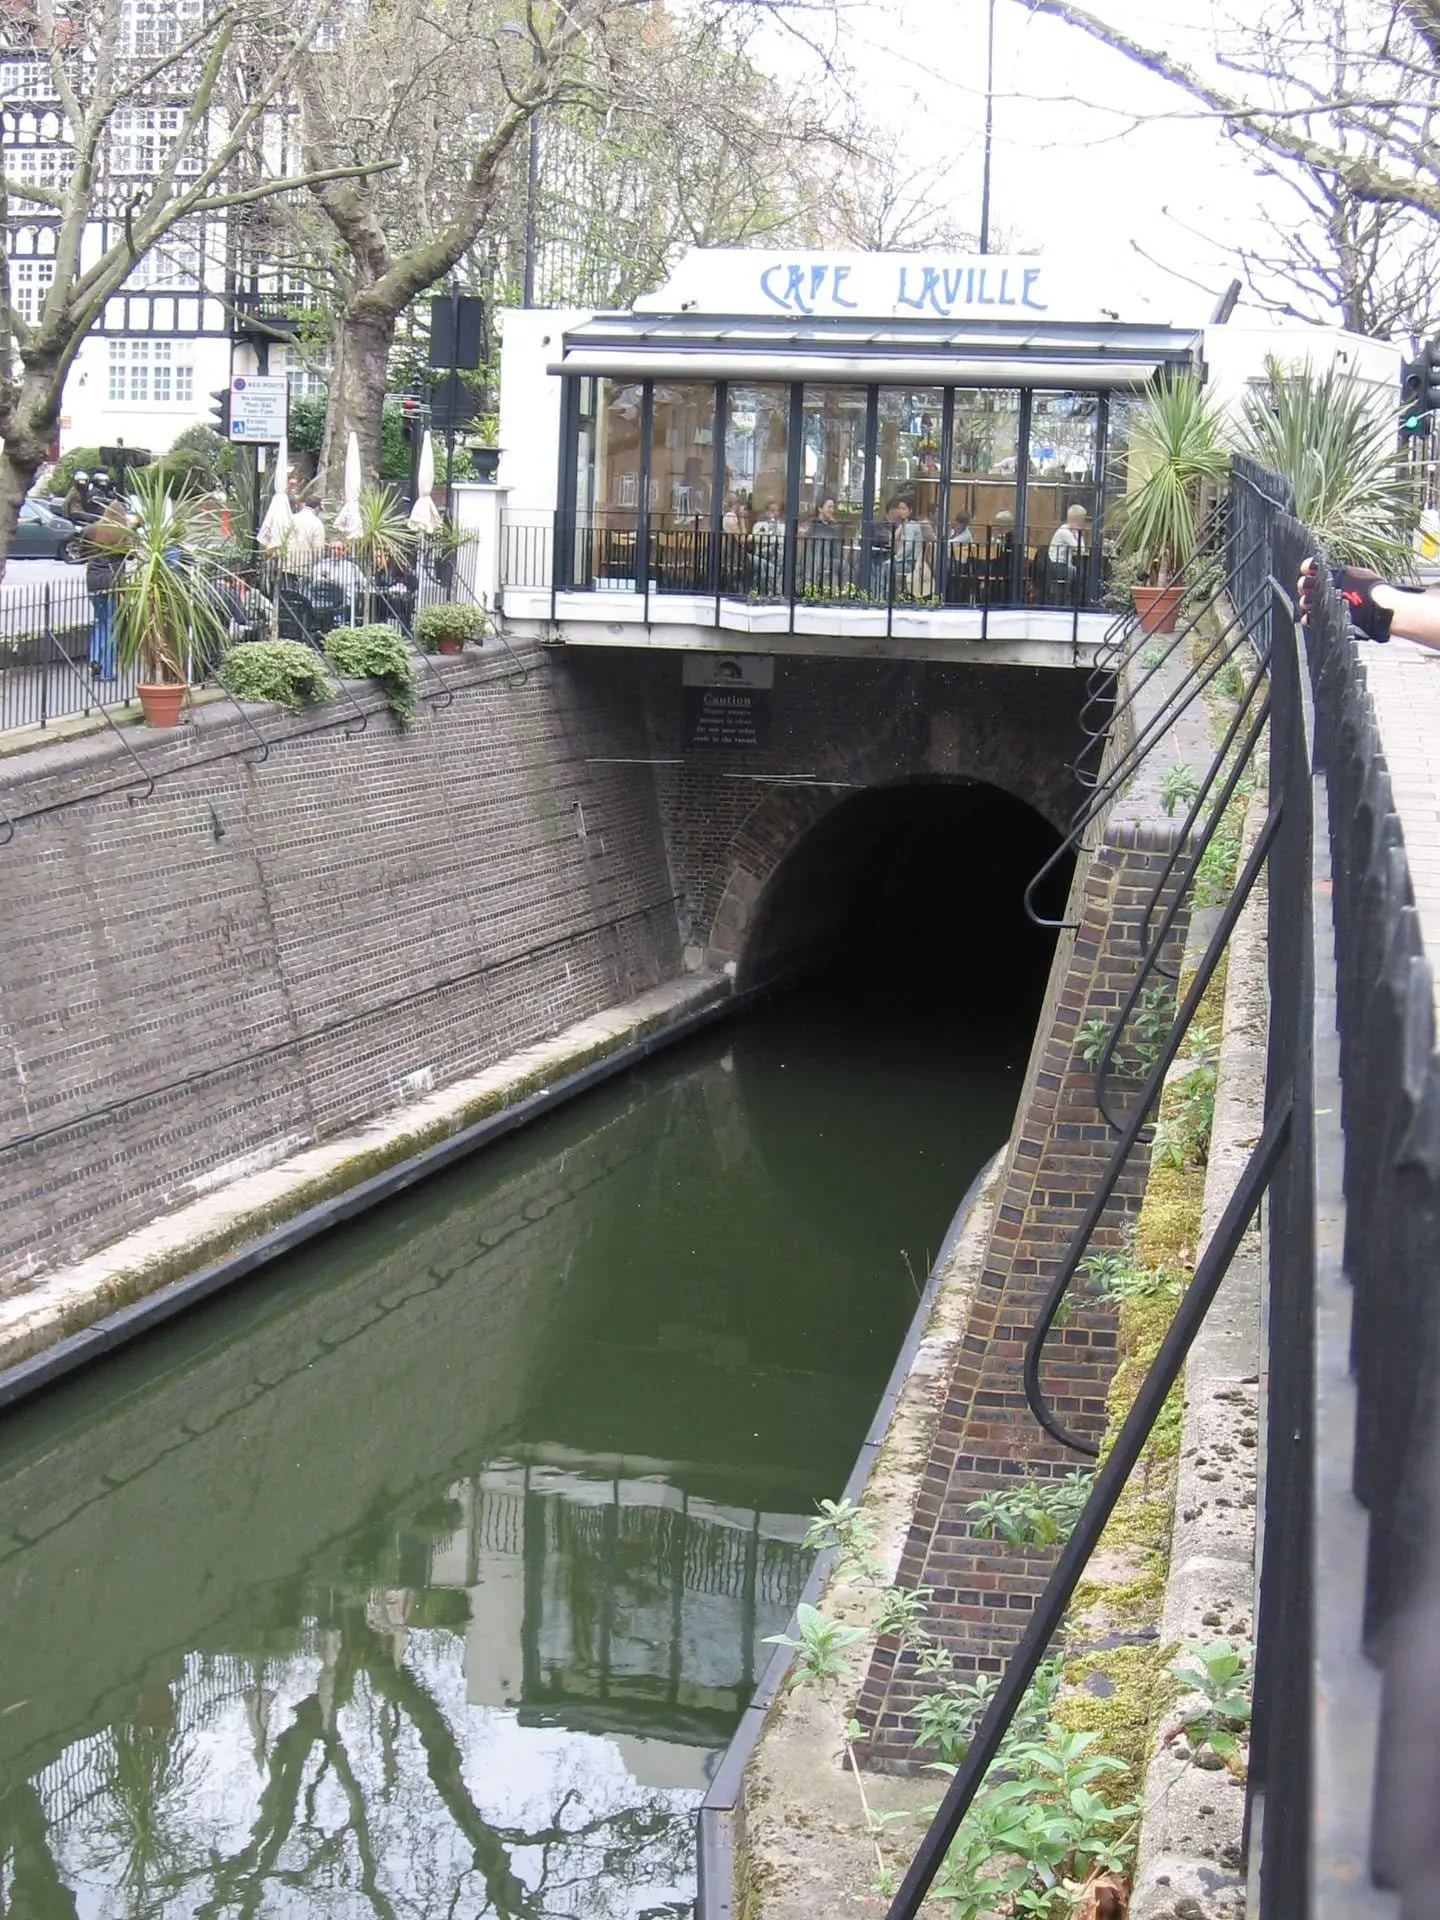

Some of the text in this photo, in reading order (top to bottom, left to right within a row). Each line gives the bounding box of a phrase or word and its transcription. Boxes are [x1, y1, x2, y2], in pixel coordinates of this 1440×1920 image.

[760, 264, 1049, 316] CAFE LAVILLE
[703, 693, 752, 705] Caution
